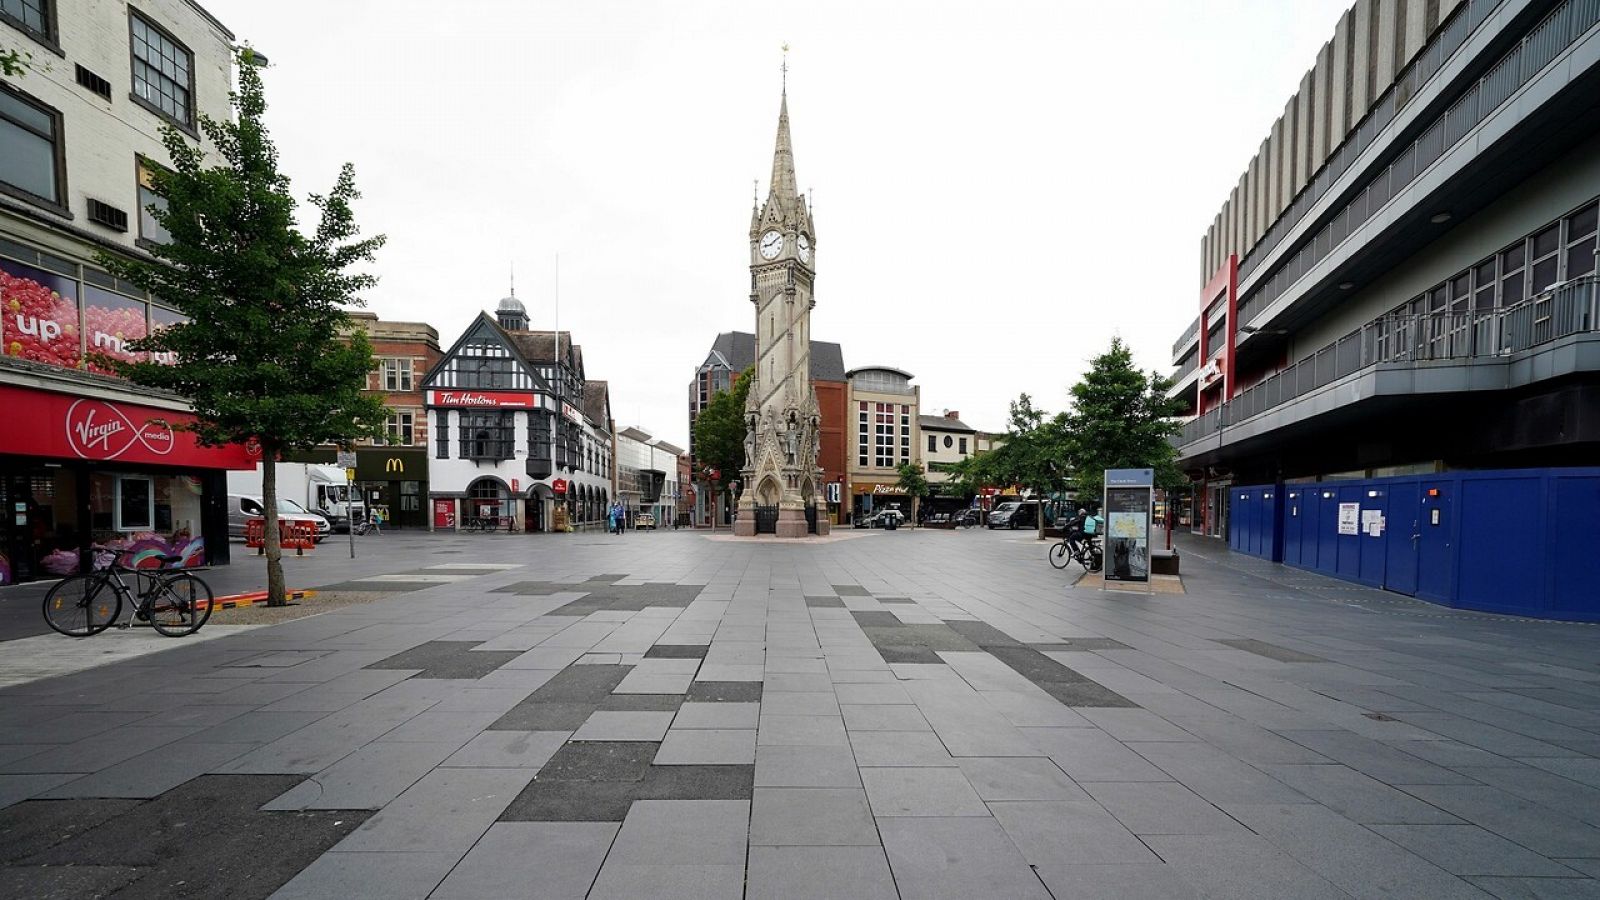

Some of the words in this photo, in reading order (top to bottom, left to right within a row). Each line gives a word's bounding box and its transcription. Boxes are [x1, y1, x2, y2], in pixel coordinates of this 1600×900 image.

[16, 315, 61, 342] up
[441, 393, 459, 404] Tim
[459, 394, 497, 405] Hortons
[76, 409, 125, 450] Virgin
[144, 432, 170, 441] media
[873, 484, 894, 493] Pizza
